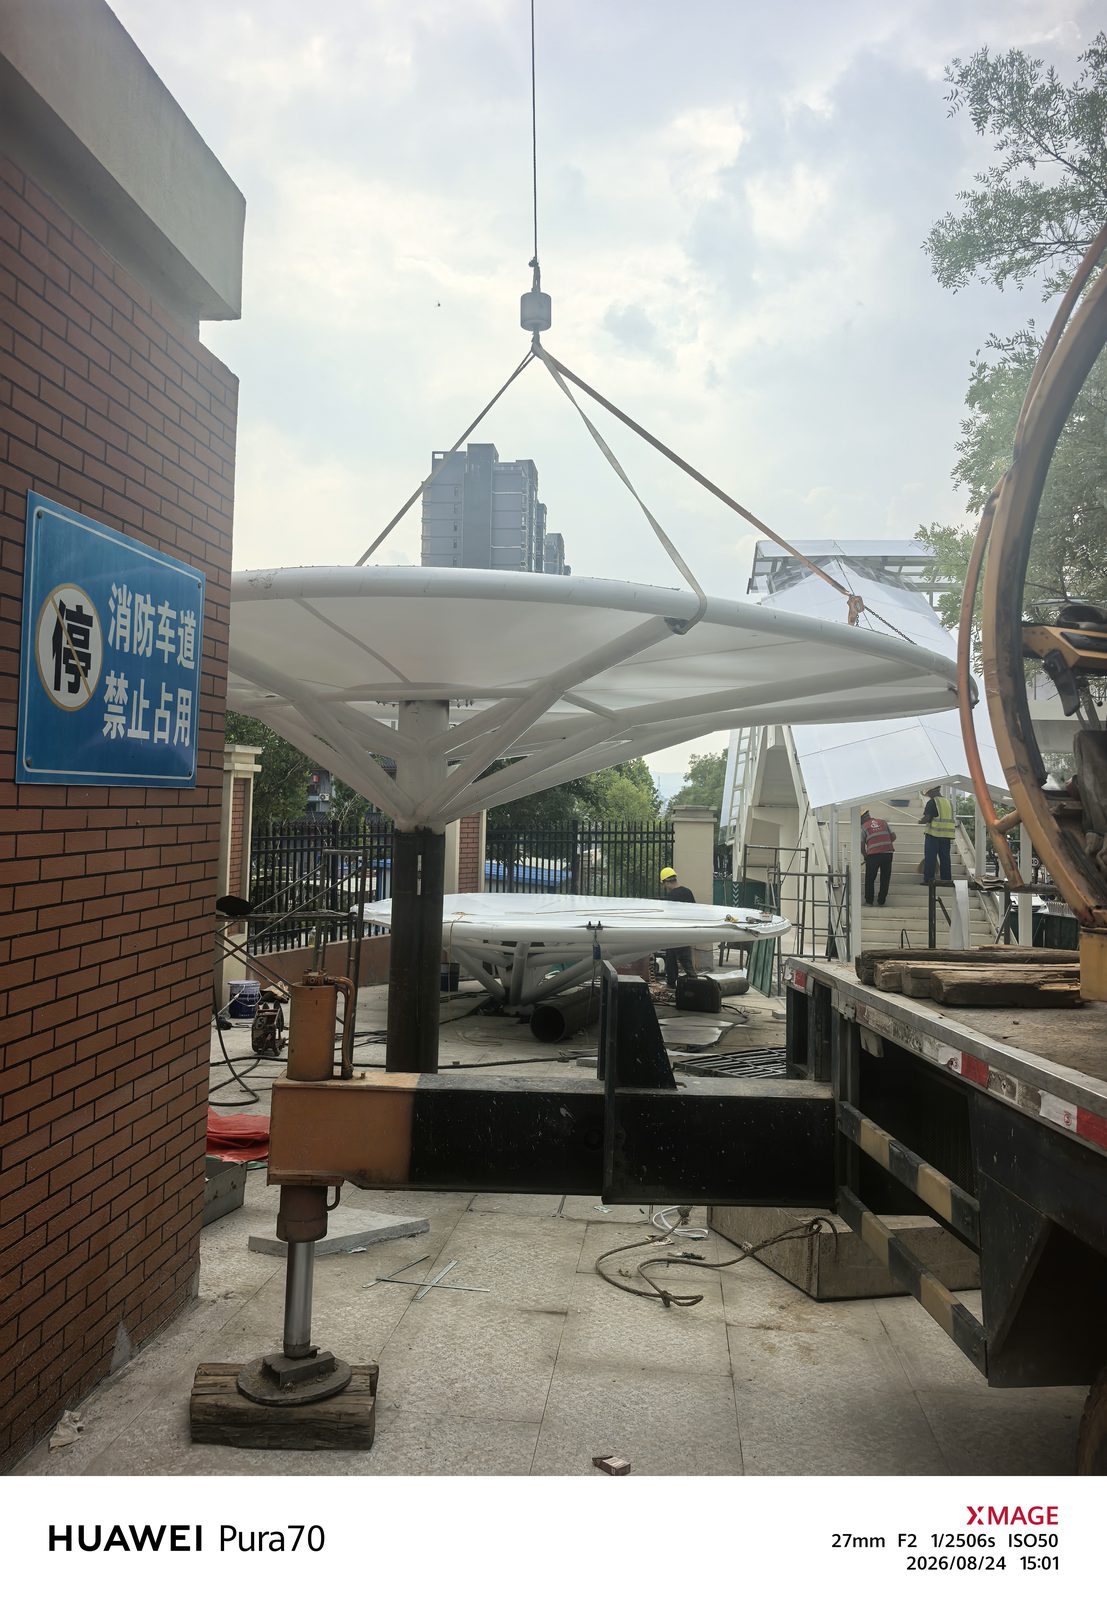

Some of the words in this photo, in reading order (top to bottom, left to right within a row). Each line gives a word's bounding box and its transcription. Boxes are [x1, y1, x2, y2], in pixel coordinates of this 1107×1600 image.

[52, 599, 93, 694] 停
[107, 582, 197, 670] 消防车道
[102, 670, 193, 748] 禁止占用
